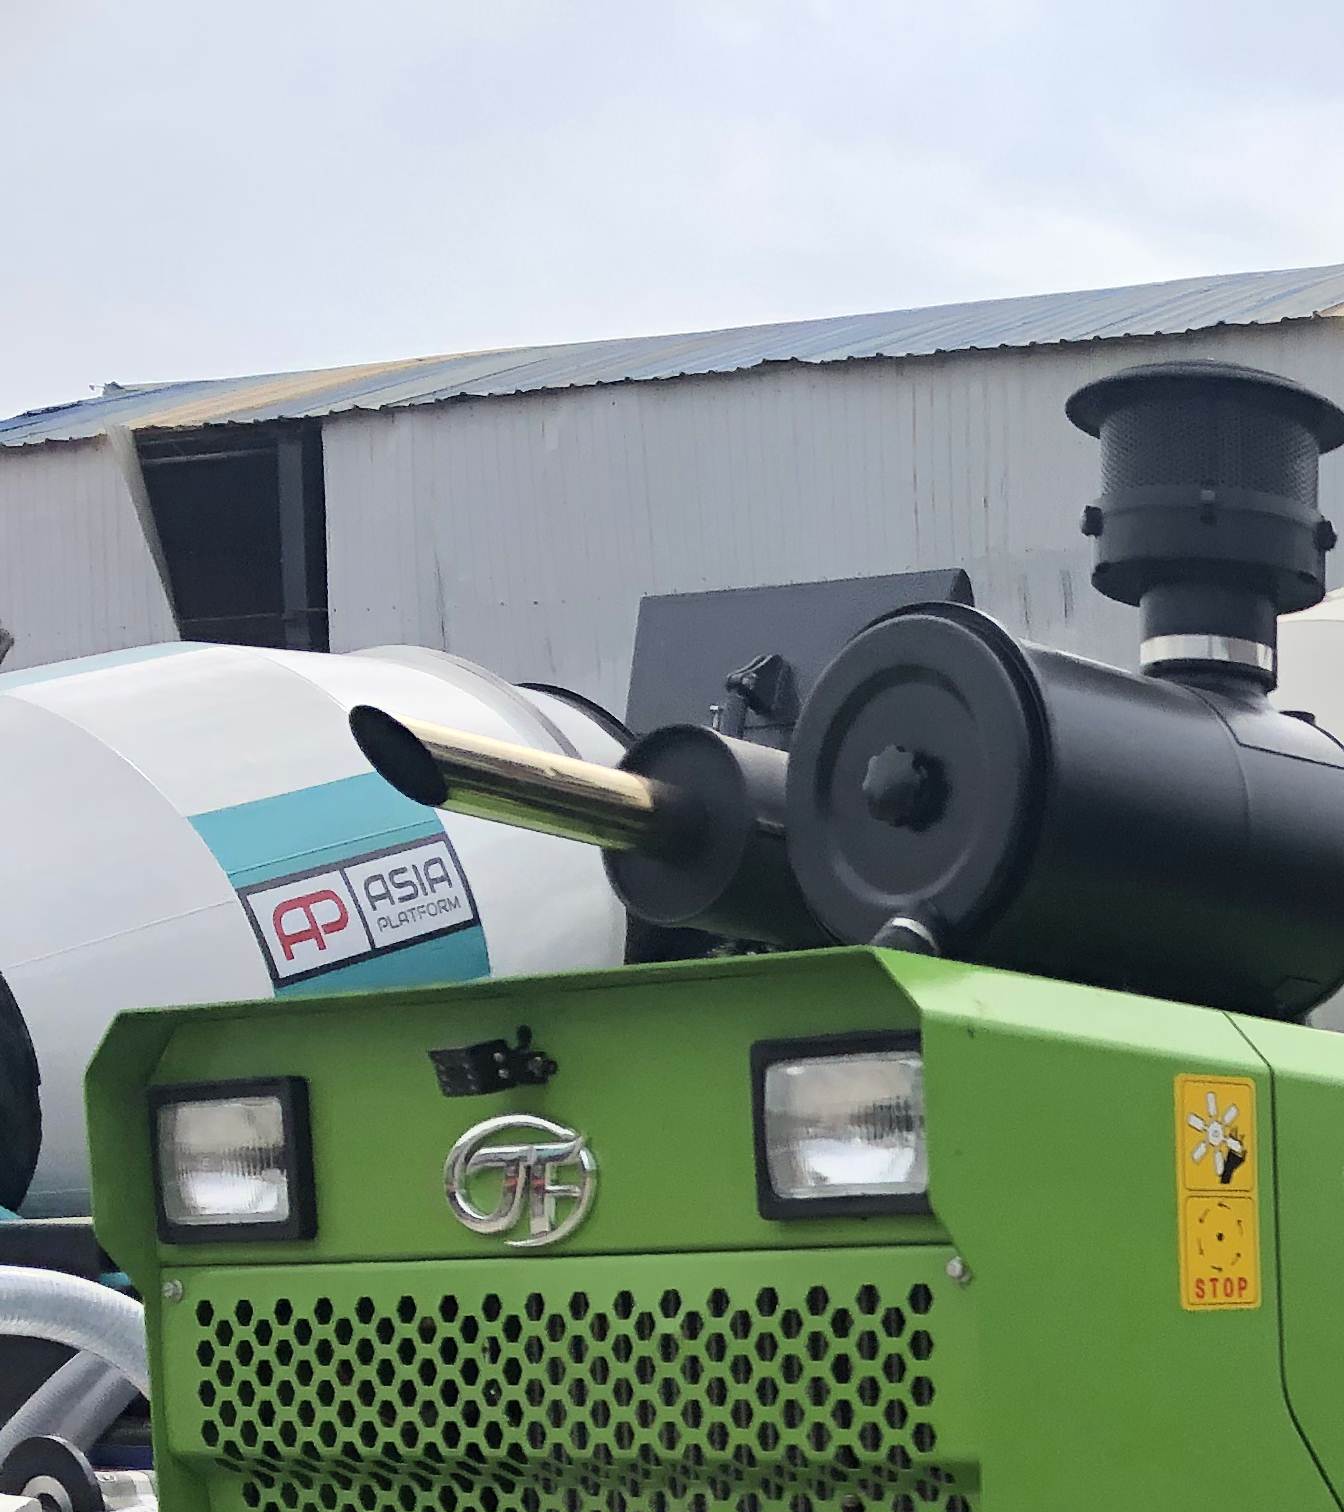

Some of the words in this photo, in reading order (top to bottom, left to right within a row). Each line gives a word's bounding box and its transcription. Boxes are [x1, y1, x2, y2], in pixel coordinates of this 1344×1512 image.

[364, 856, 453, 911] ASIA
[377, 895, 461, 933] PLATFORM
[1195, 1277, 1248, 1299] STOP
